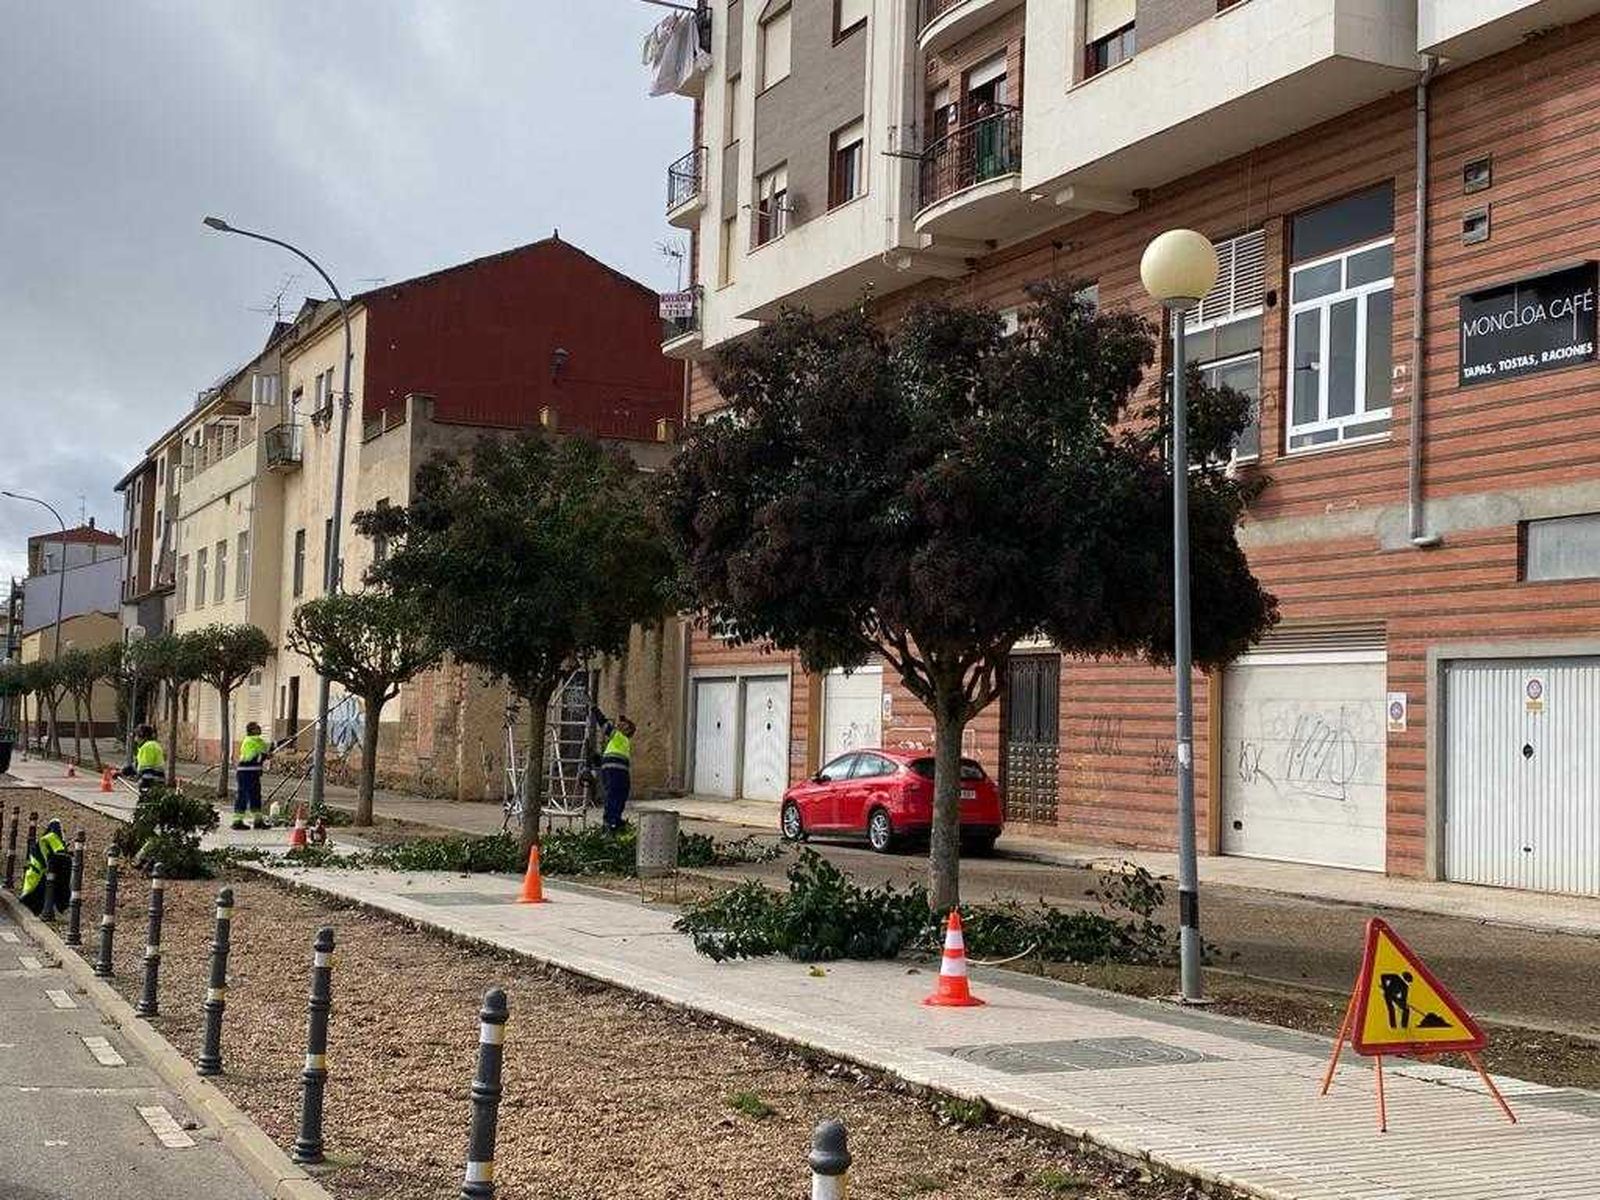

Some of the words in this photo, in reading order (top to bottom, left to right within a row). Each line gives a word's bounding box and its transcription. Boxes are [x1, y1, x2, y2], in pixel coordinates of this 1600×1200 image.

[1463, 300, 1547, 339] MONCLOA
[1549, 287, 1593, 320] CAFÉ
[1463, 364, 1496, 378] TAPAS,
[1500, 354, 1538, 371] TOSTAS,
[1541, 342, 1593, 362] RACIONES
